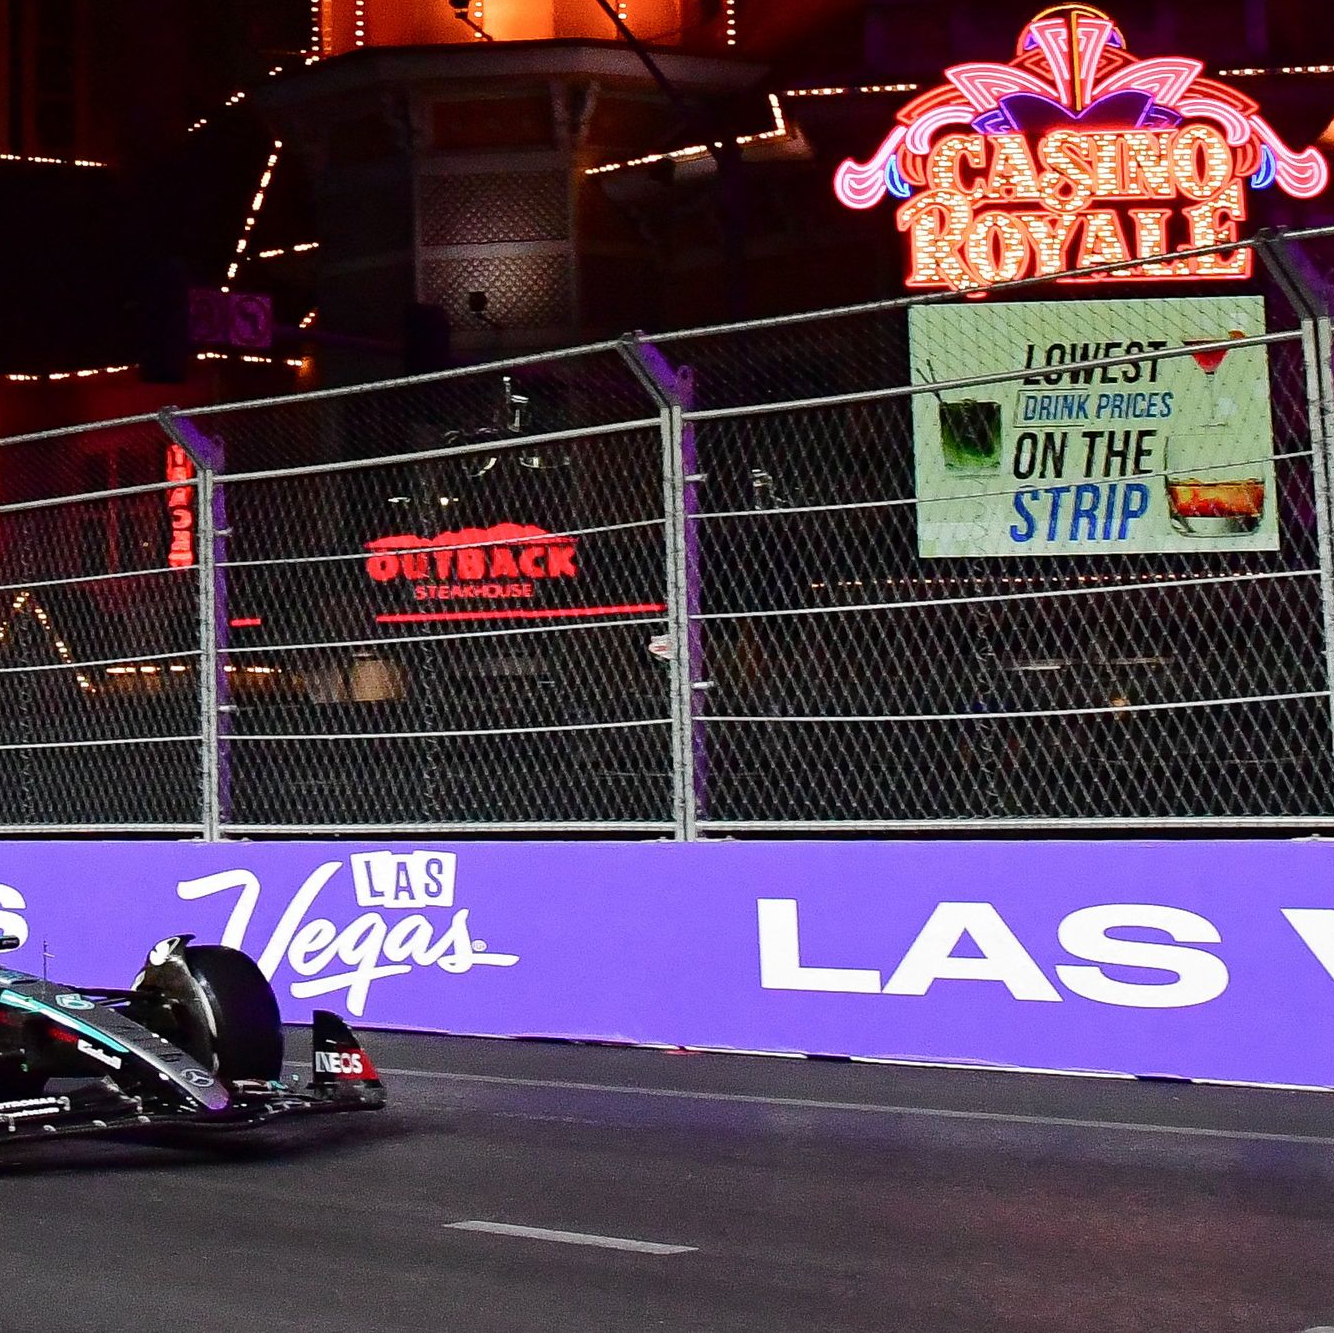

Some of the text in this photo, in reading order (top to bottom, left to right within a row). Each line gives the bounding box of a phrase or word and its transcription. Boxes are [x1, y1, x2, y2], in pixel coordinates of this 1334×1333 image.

[925, 126, 1234, 214] CASINO
[897, 180, 1253, 296] ROYALE
[1022, 340, 1168, 386] LOWEST
[1023, 391, 1175, 422] DRINK PRICES
[1013, 429, 1158, 480] ON THE
[1009, 481, 1151, 543] STRIP
[366, 545, 577, 582] OUTBACK
[415, 583, 534, 601] STEAKHOUSE
[362, 857, 444, 902] LAS
[176, 861, 520, 1016] Vegas
[758, 898, 1230, 1009] LAS
[315, 1050, 364, 1075] INEOS
